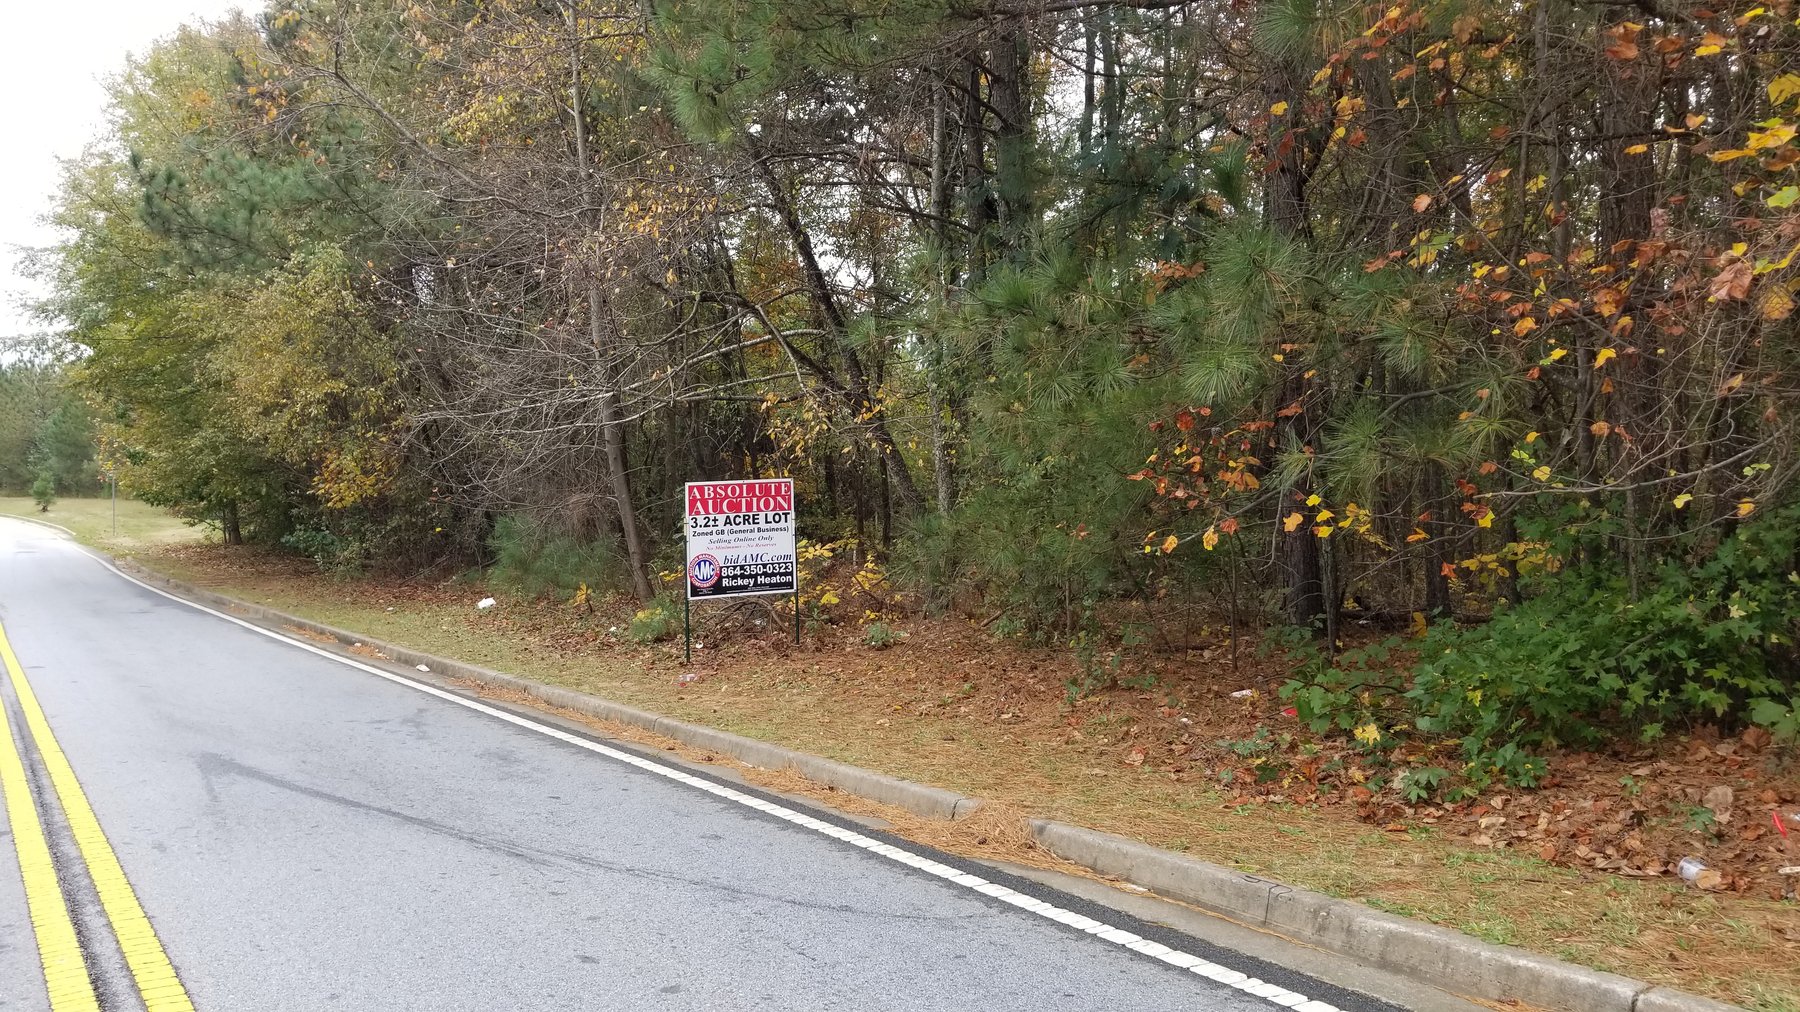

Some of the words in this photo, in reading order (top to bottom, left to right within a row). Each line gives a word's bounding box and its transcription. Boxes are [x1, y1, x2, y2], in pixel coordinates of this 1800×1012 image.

[690, 483, 791, 499] ABSOLUTE
[692, 496, 789, 515] AUCTION
[691, 516, 719, 528] 3.2±
[724, 513, 760, 526] ACRE
[765, 512, 790, 524] LOT
[692, 529, 713, 537] Zoned
[727, 527, 755, 536] (General
[694, 561, 715, 580] AMC
[721, 563, 792, 576] 864-350-0323
[722, 578, 754, 587] Rickey
[757, 575, 792, 584] Heaton
